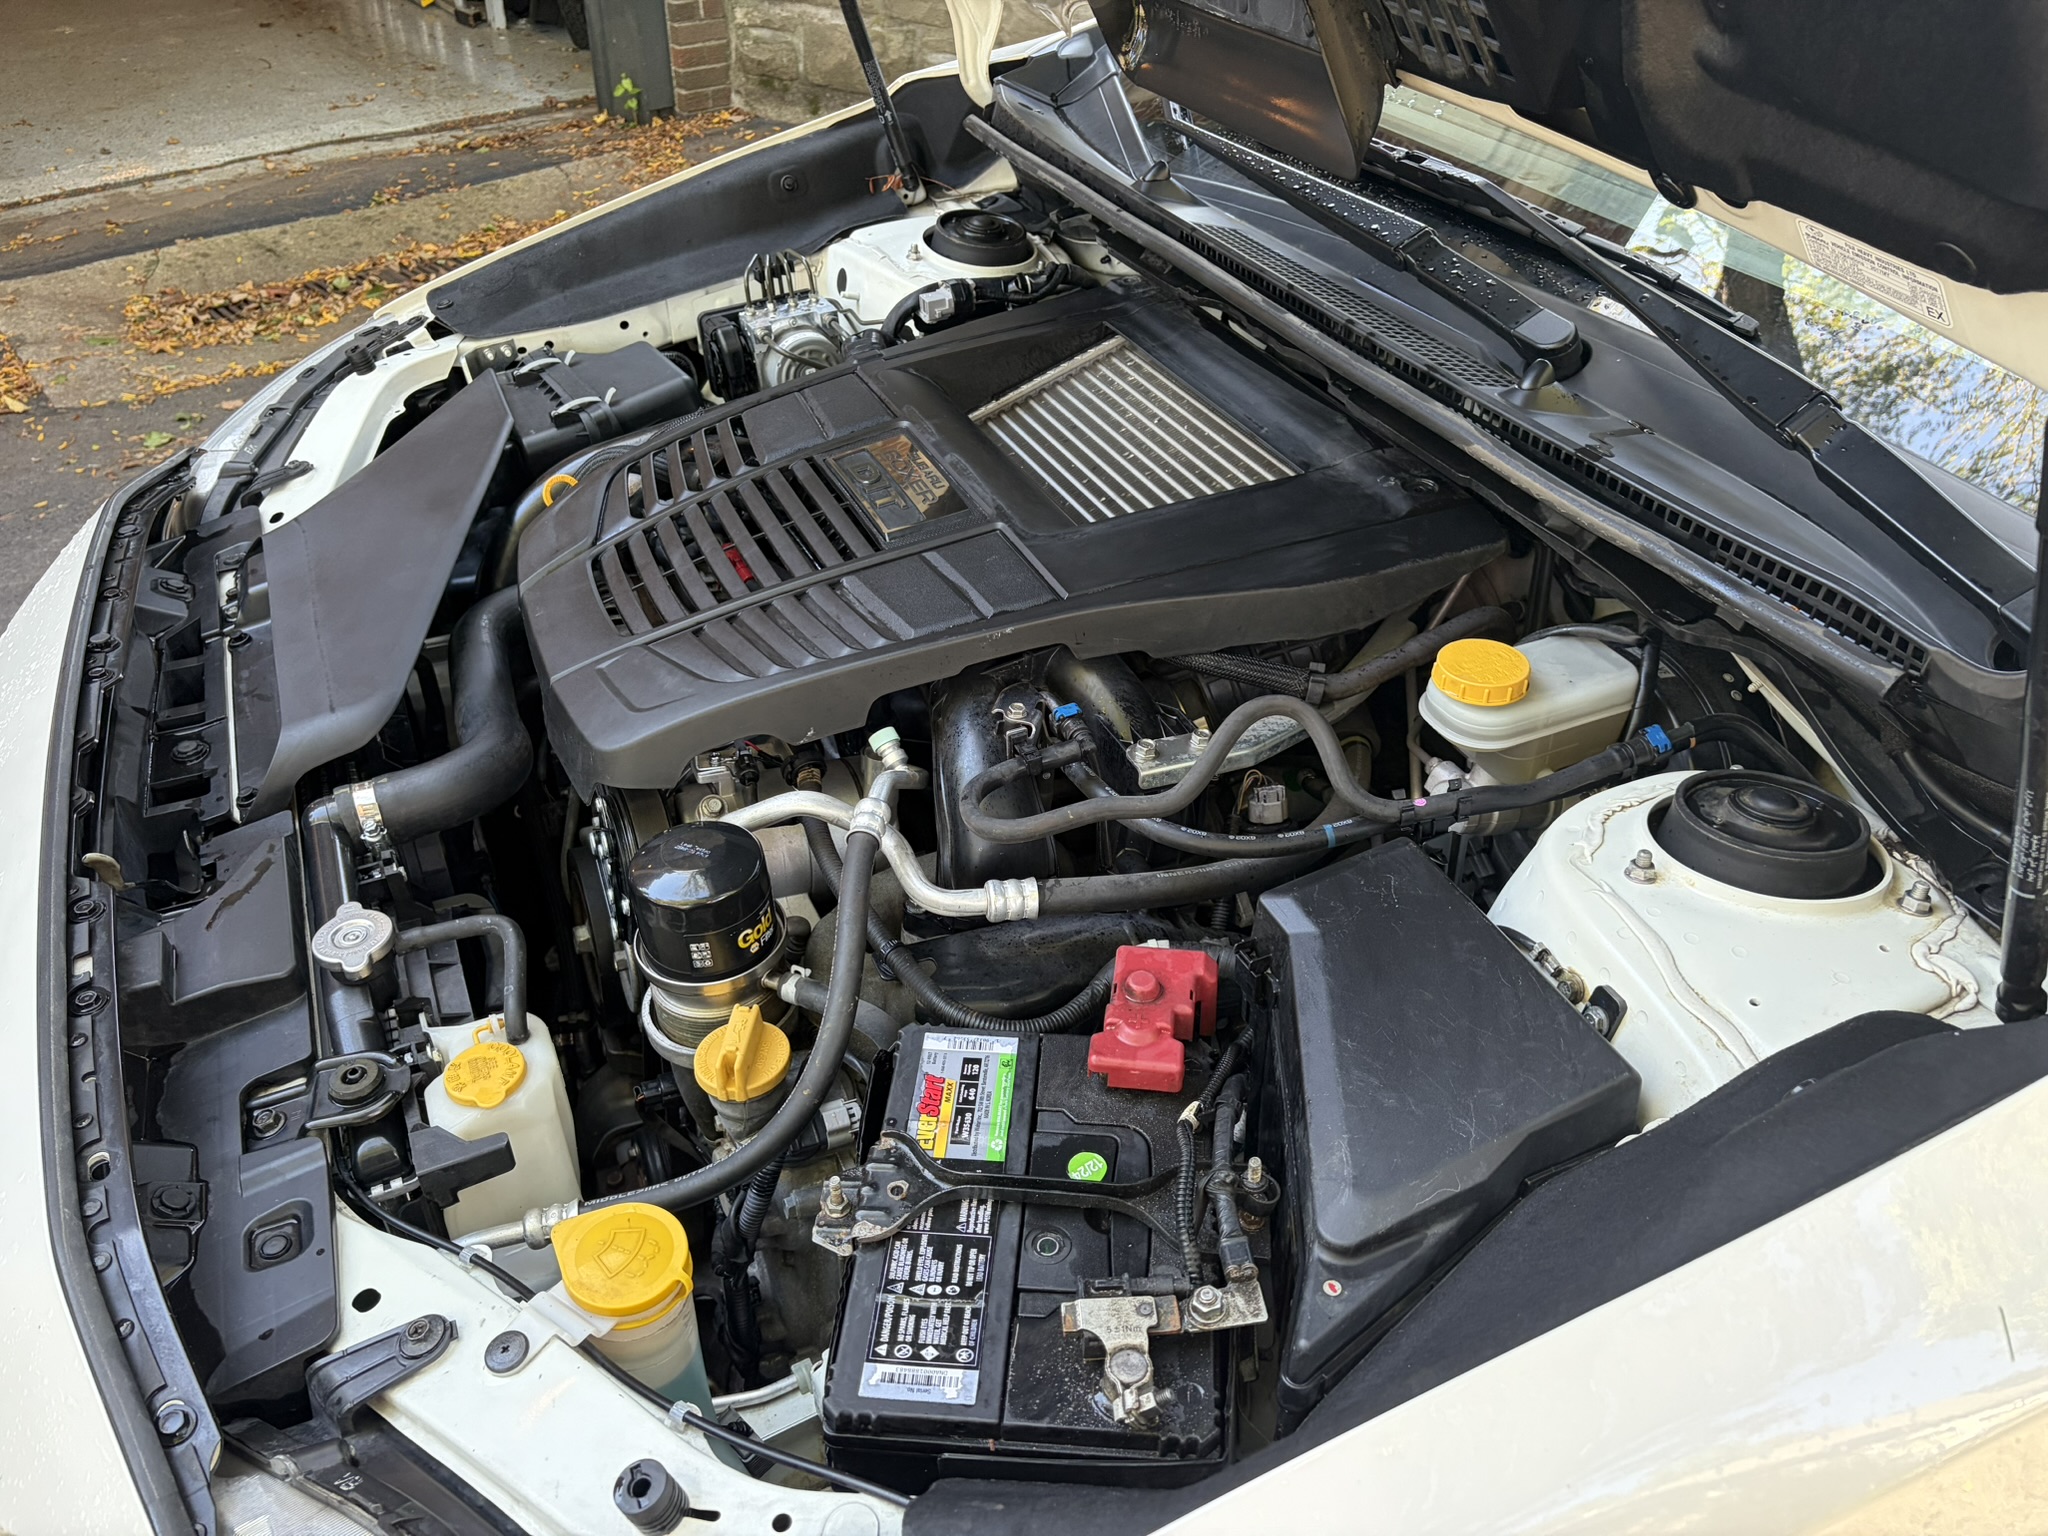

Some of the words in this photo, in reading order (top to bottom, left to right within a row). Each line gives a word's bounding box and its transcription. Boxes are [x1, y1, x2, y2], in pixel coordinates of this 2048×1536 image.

[1926, 306, 1946, 323] EX
[849, 461, 909, 510] DIT
[884, 450, 940, 504] BOXER
[908, 451, 945, 490] SUBARU
[737, 906, 773, 949] Gold
[488, 1042, 521, 1086] COOLANT
[771, 1029, 786, 1064] ENGINE
[971, 1064, 979, 1075] 120
[945, 1082, 954, 1103] MAXX
[967, 1087, 976, 1100] 640
[915, 1073, 946, 1150] EverStart
[1071, 1158, 1104, 1180] 12/24
